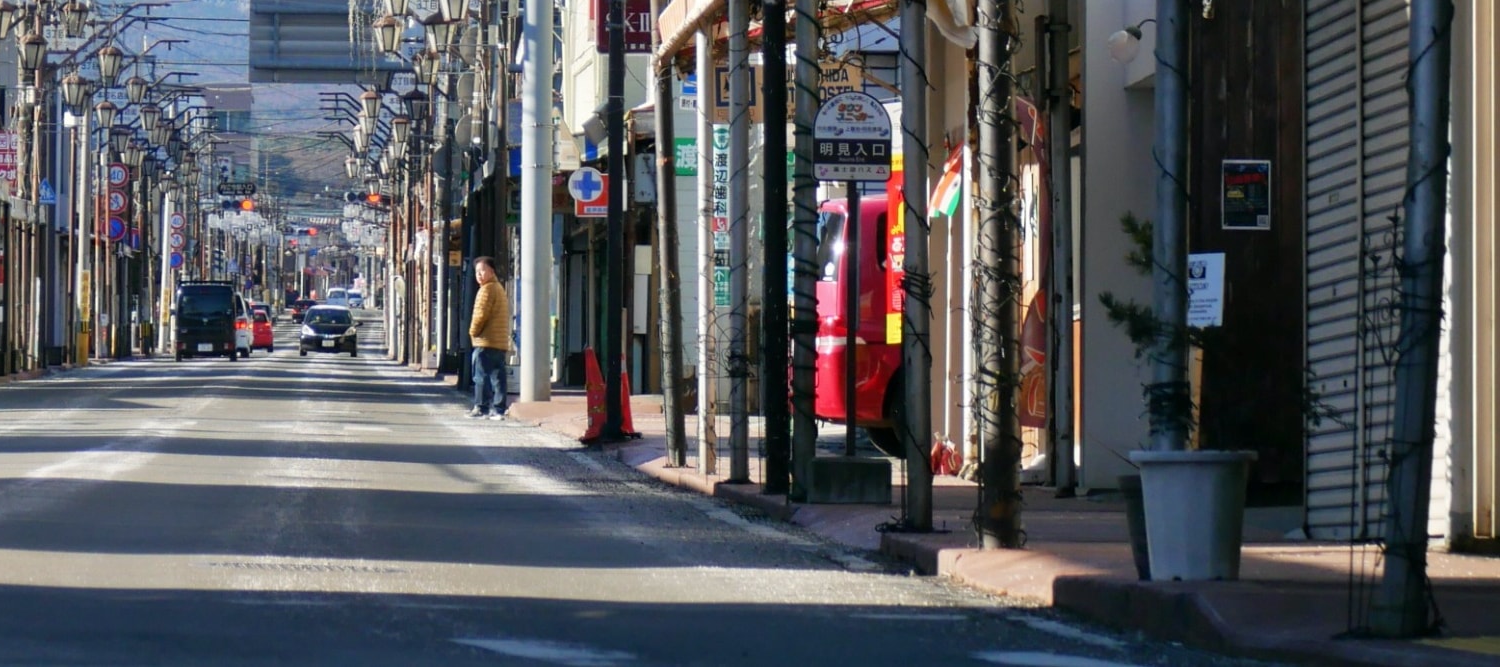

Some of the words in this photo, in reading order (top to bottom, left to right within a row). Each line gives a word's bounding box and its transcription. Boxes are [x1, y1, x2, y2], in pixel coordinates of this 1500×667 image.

[820, 143, 884, 156] 明見入口
[111, 170, 122, 180] 40
